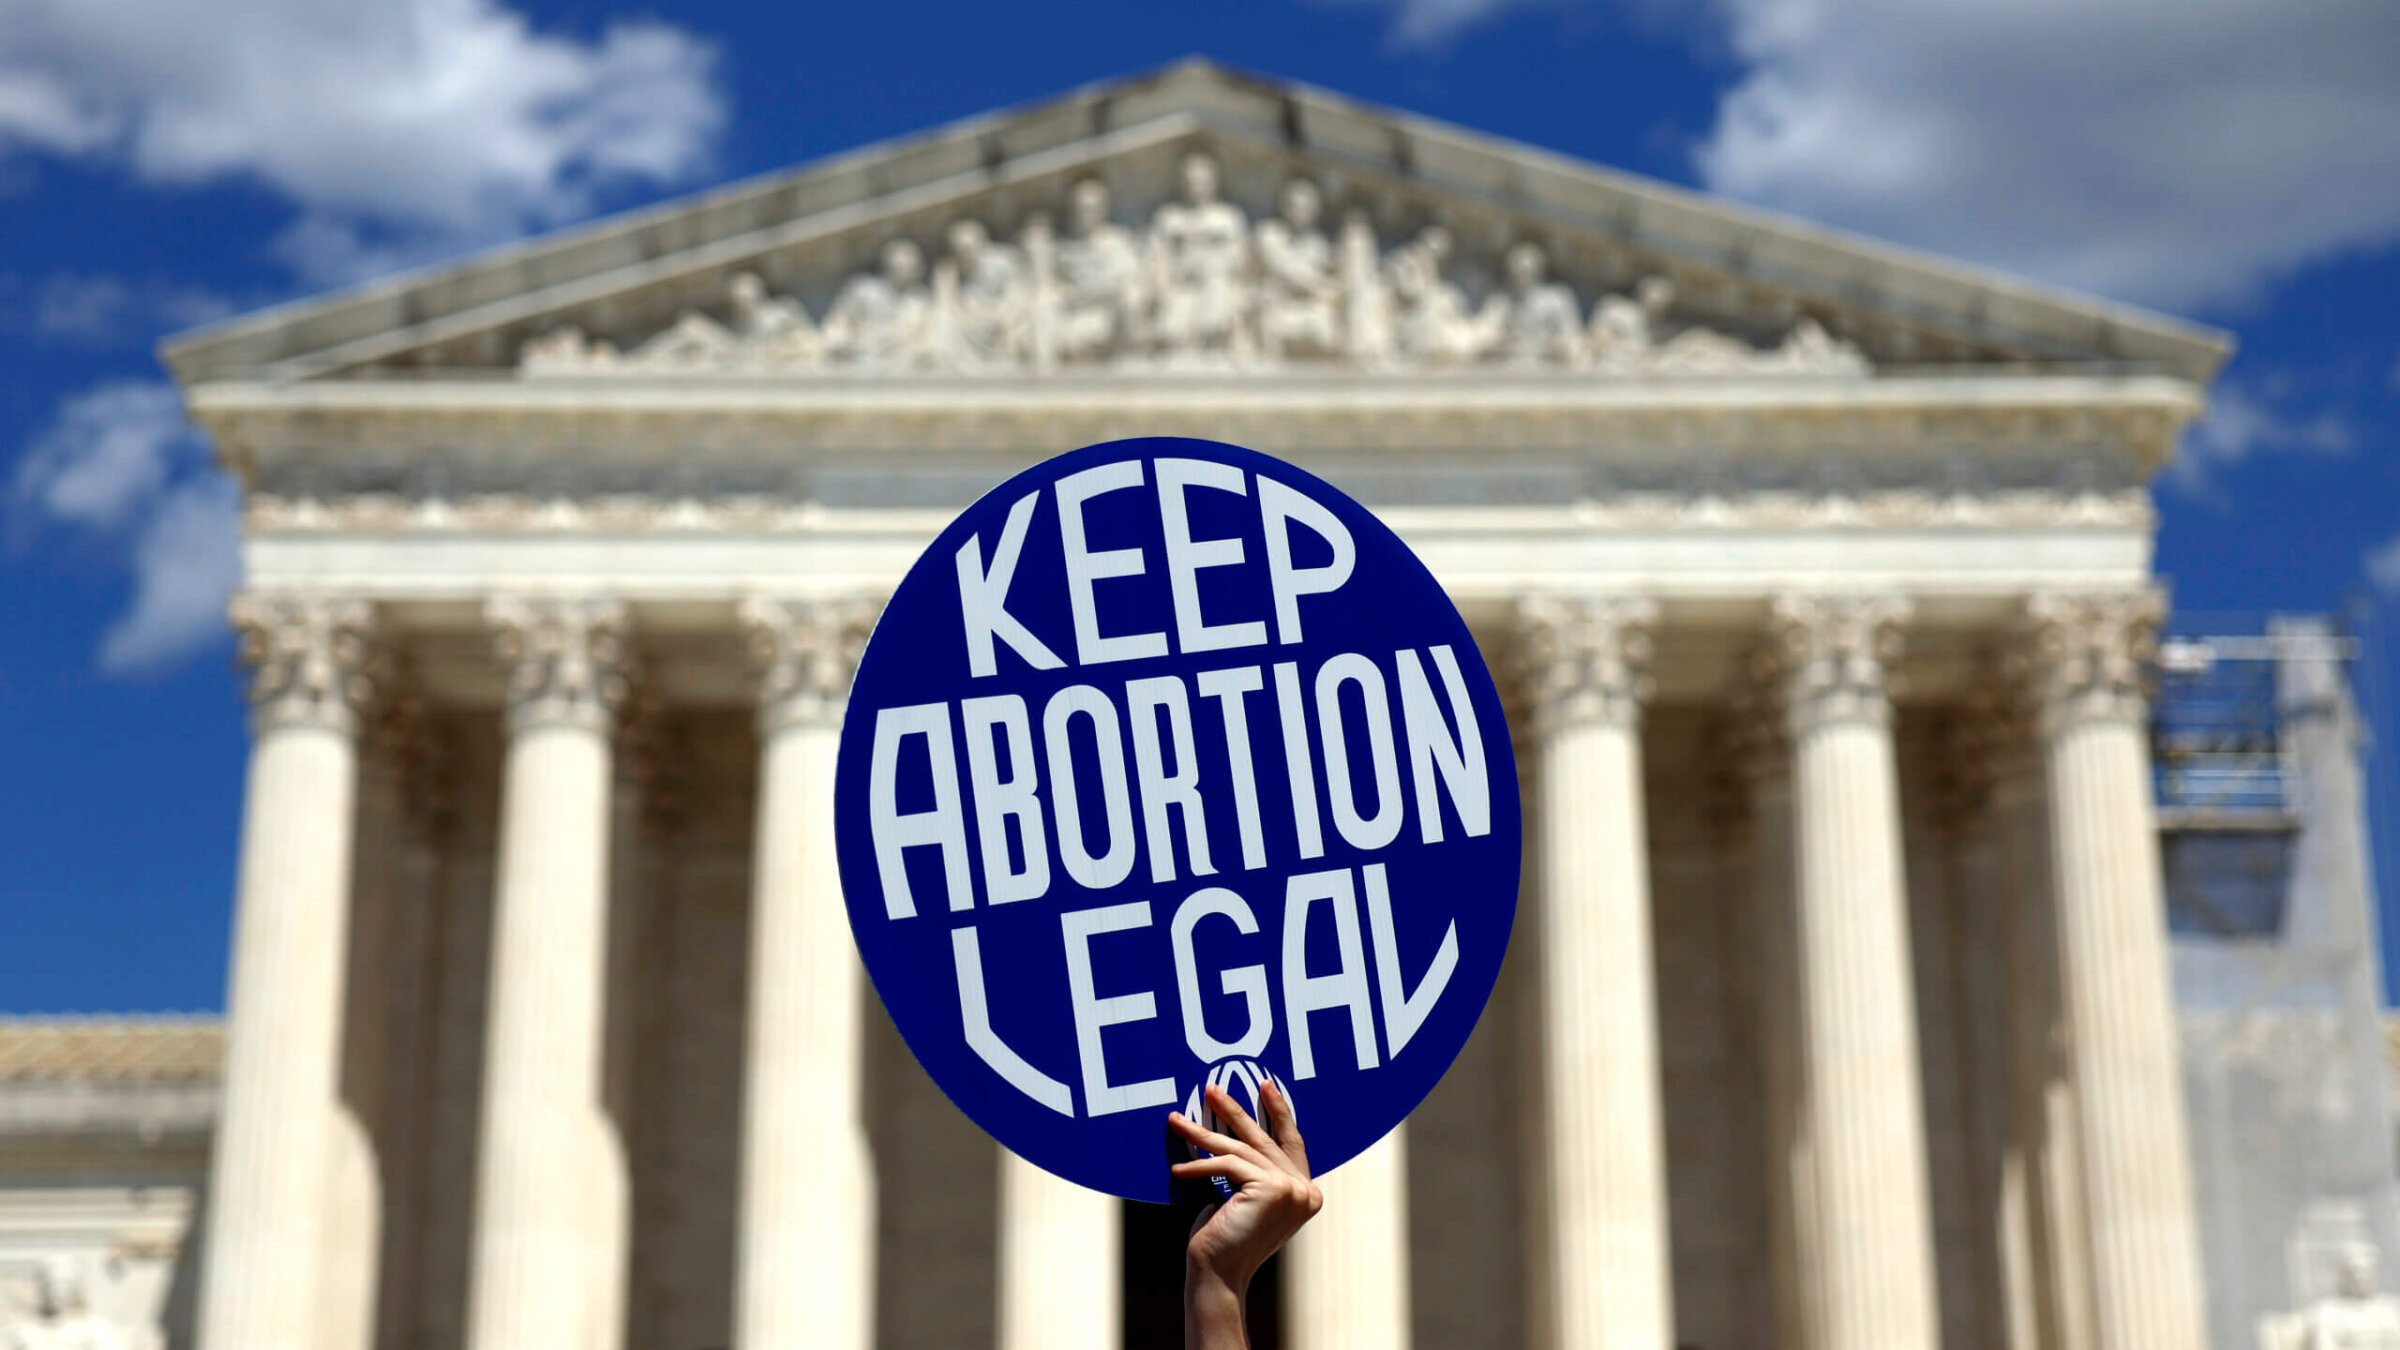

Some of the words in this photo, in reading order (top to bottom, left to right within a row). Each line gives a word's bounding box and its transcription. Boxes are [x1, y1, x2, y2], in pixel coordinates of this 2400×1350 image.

[956, 458, 1355, 677] KEEP
[870, 645, 1490, 920] ABORTION
[951, 863, 1458, 1117] LEGAL
